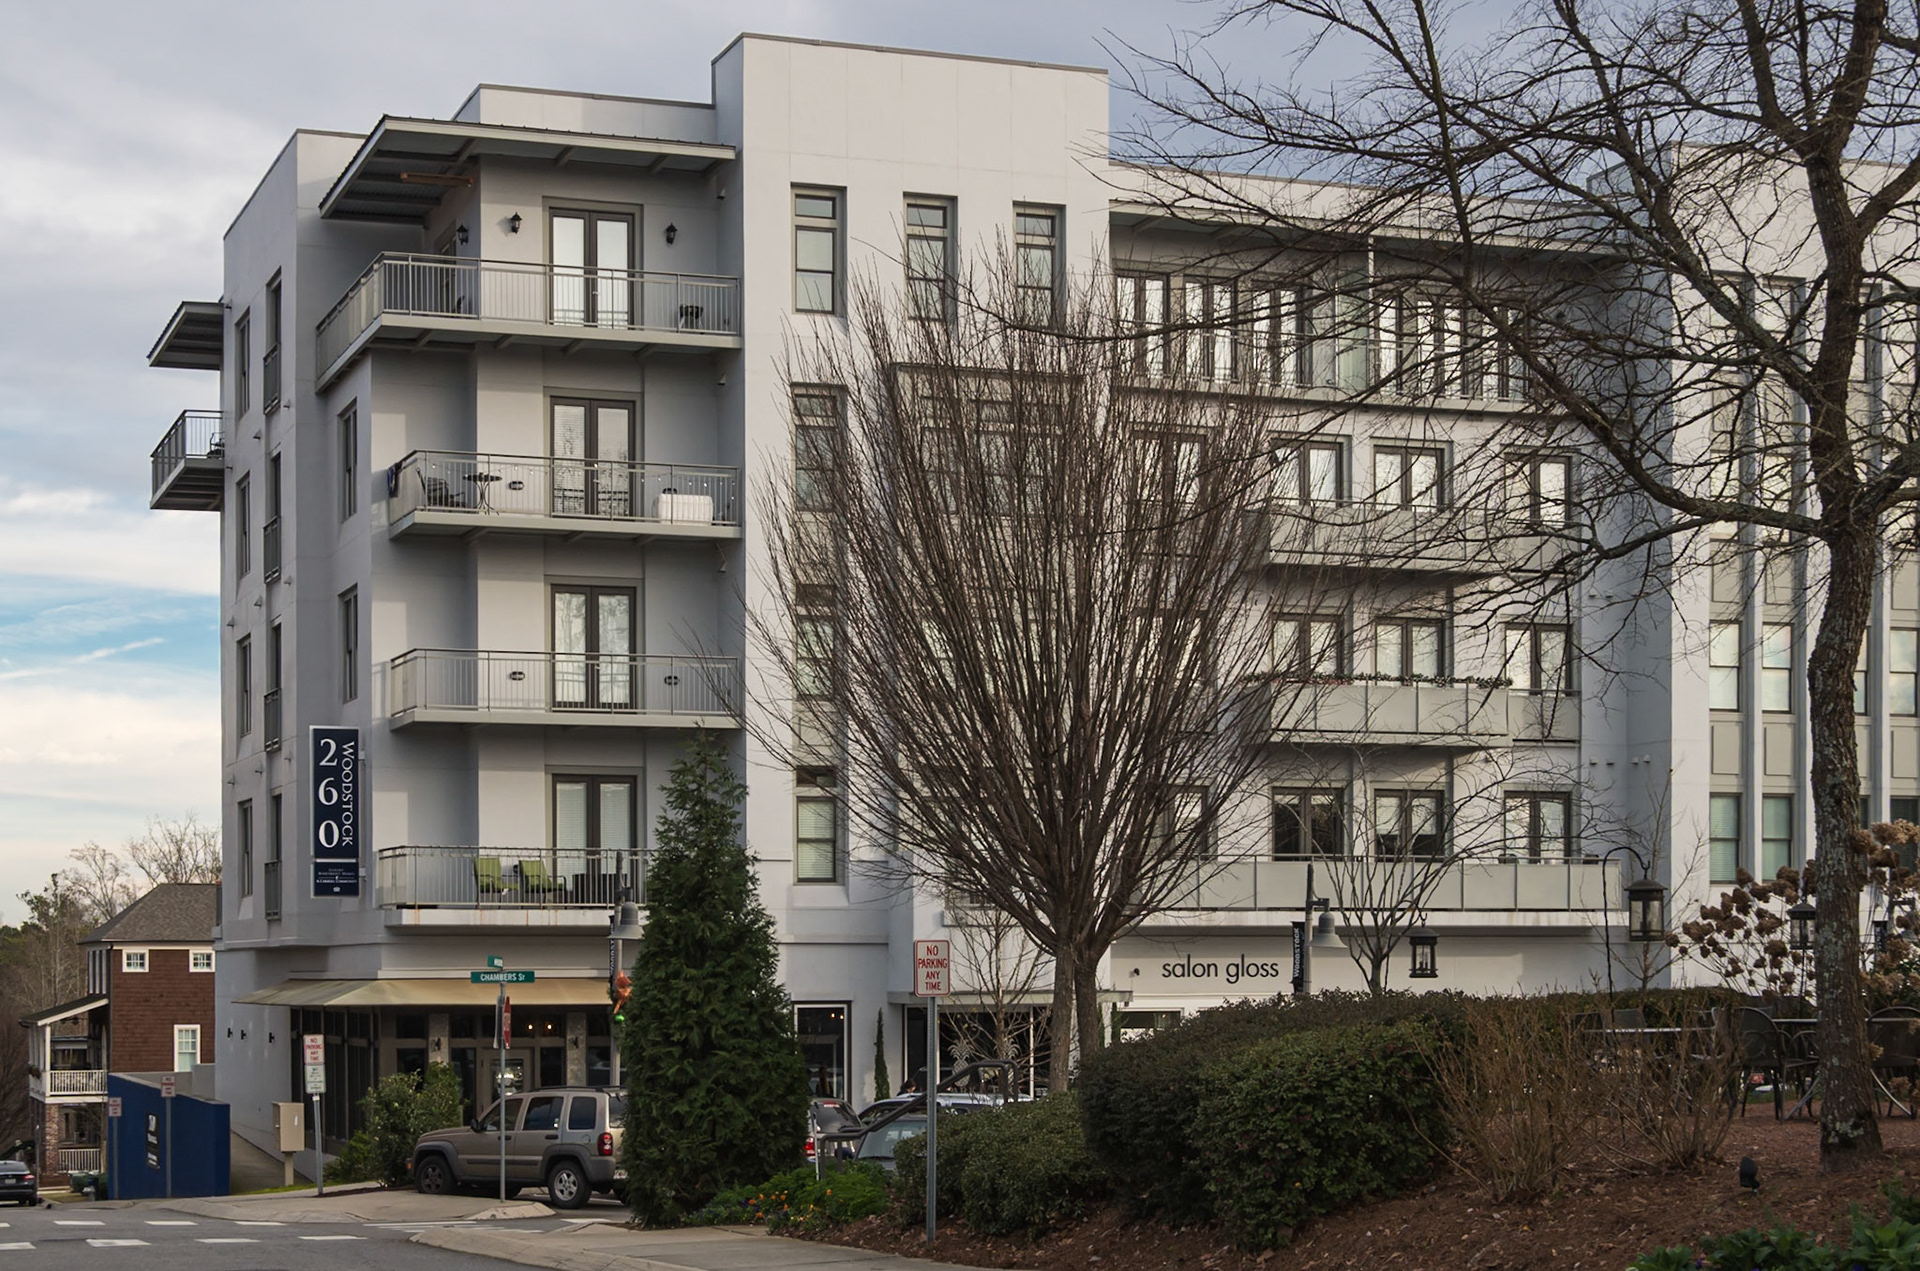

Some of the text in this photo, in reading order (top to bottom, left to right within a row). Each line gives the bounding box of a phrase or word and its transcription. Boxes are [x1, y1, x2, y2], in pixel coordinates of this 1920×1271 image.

[318, 738, 340, 848] 260
[342, 741, 355, 847] WOODSTOCK
[926, 945, 939, 956] NO
[918, 958, 948, 969] PARKING
[1162, 953, 1279, 984] salon gloss
[480, 973, 517, 982] CHAMBERS
[925, 970, 940, 980] ANY
[925, 981, 942, 991] TIME
